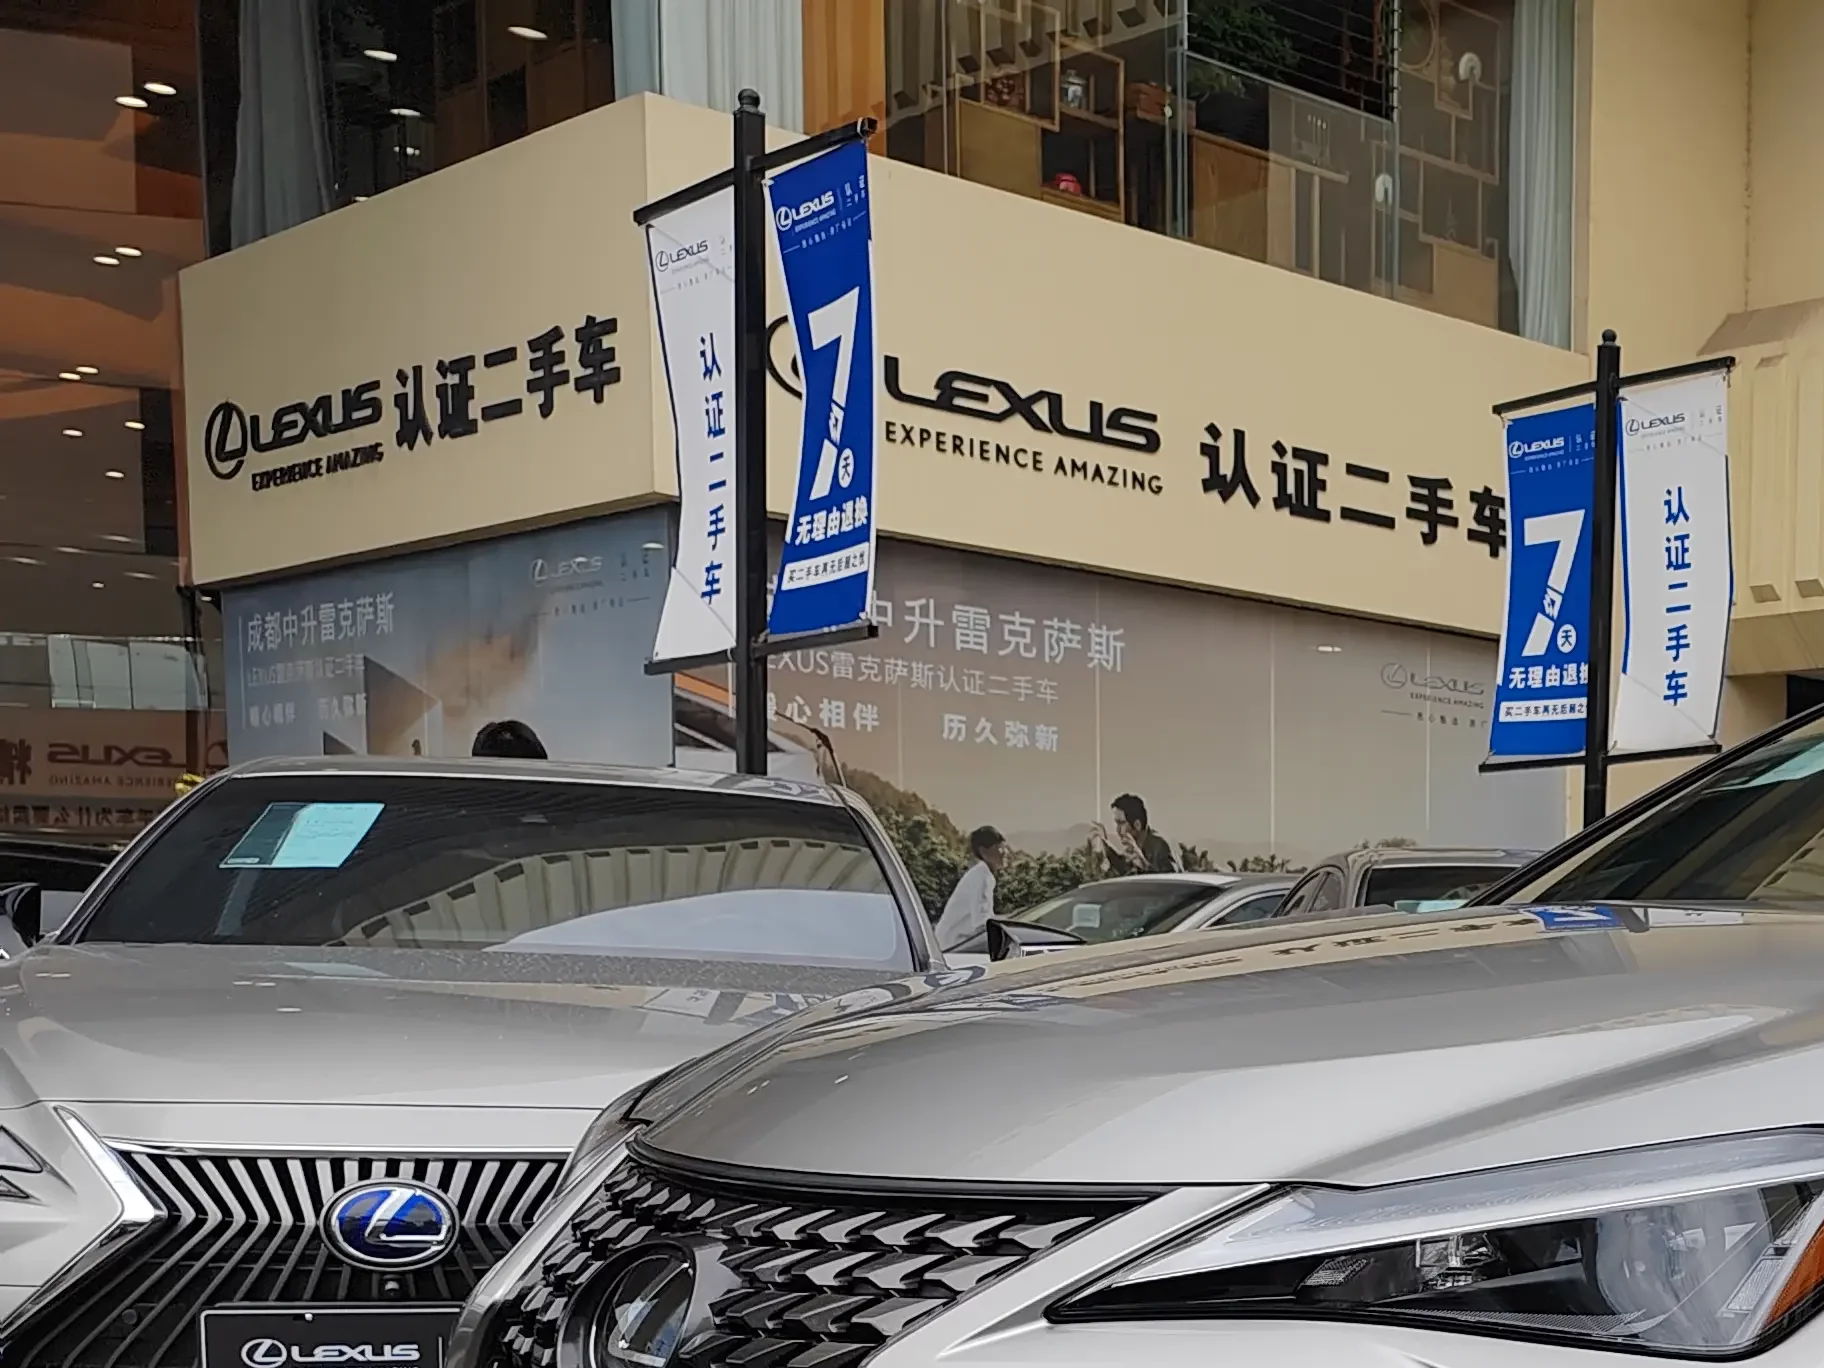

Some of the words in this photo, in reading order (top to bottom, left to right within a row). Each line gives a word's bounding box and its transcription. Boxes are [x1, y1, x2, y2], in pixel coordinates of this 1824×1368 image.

[790, 190, 835, 221] LEXUS
[669, 239, 709, 264] LEXUS
[249, 379, 383, 453] LEXUS
[393, 315, 621, 452] 认证二手车
[807, 286, 860, 501] 7
[883, 355, 1161, 453] LEXUS
[1524, 436, 1565, 454] LEXUS
[1641, 412, 1686, 430] LEXUS
[700, 332, 728, 606] 认证二手车
[885, 421, 1044, 473] EXPERIENCE
[1054, 454, 1164, 496] AMAZING
[1200, 422, 1506, 559] 认证二手车
[795, 495, 868, 546] 无理由退换
[1521, 508, 1586, 657] 7
[1663, 486, 1692, 706] 认证二手车
[248, 592, 395, 652] 成都中升雷克萨斯
[942, 713, 1058, 752] 历久弥新
[290, 1343, 421, 1362] LEXUS
